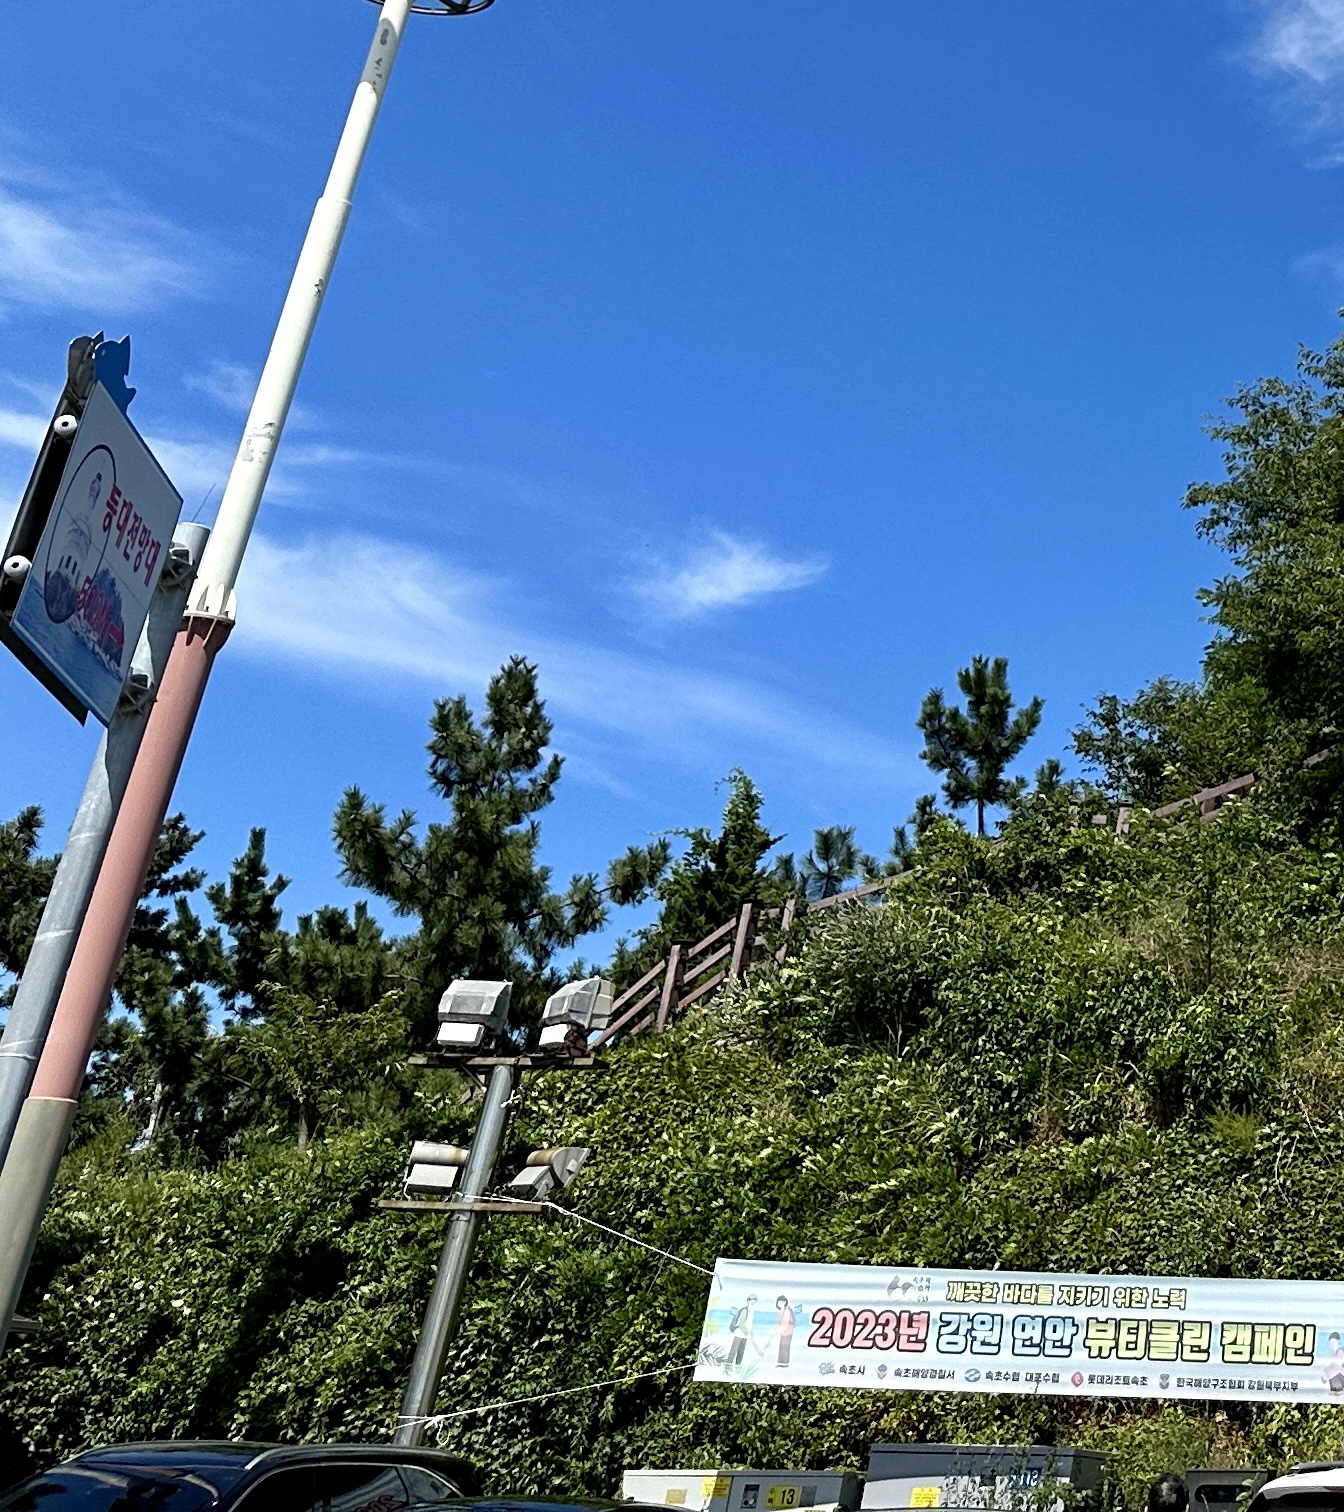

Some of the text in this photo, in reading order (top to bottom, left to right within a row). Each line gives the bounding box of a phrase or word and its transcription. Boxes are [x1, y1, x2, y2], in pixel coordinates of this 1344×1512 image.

[103, 482, 162, 588] 등대전망대
[945, 1280, 1000, 1304] 깨끗한
[1002, 1282, 1055, 1306] 바다를
[1057, 1284, 1110, 1308] 지키기
[1113, 1285, 1149, 1309] 위한
[1151, 1287, 1188, 1311] 노력
[807, 1306, 1317, 1367] 2023년 강원 연안 뷰티클린 캠페인
[839, 1364, 866, 1376] 속초시
[893, 1367, 956, 1380] 속초해양경찰서
[985, 1370, 1060, 1384] 속초수협 대포수협
[1087, 1374, 1149, 1386] 롯데리조트속초
[1176, 1377, 1245, 1390] 한국해양구조협회
[781, 1488, 796, 1505] 13
